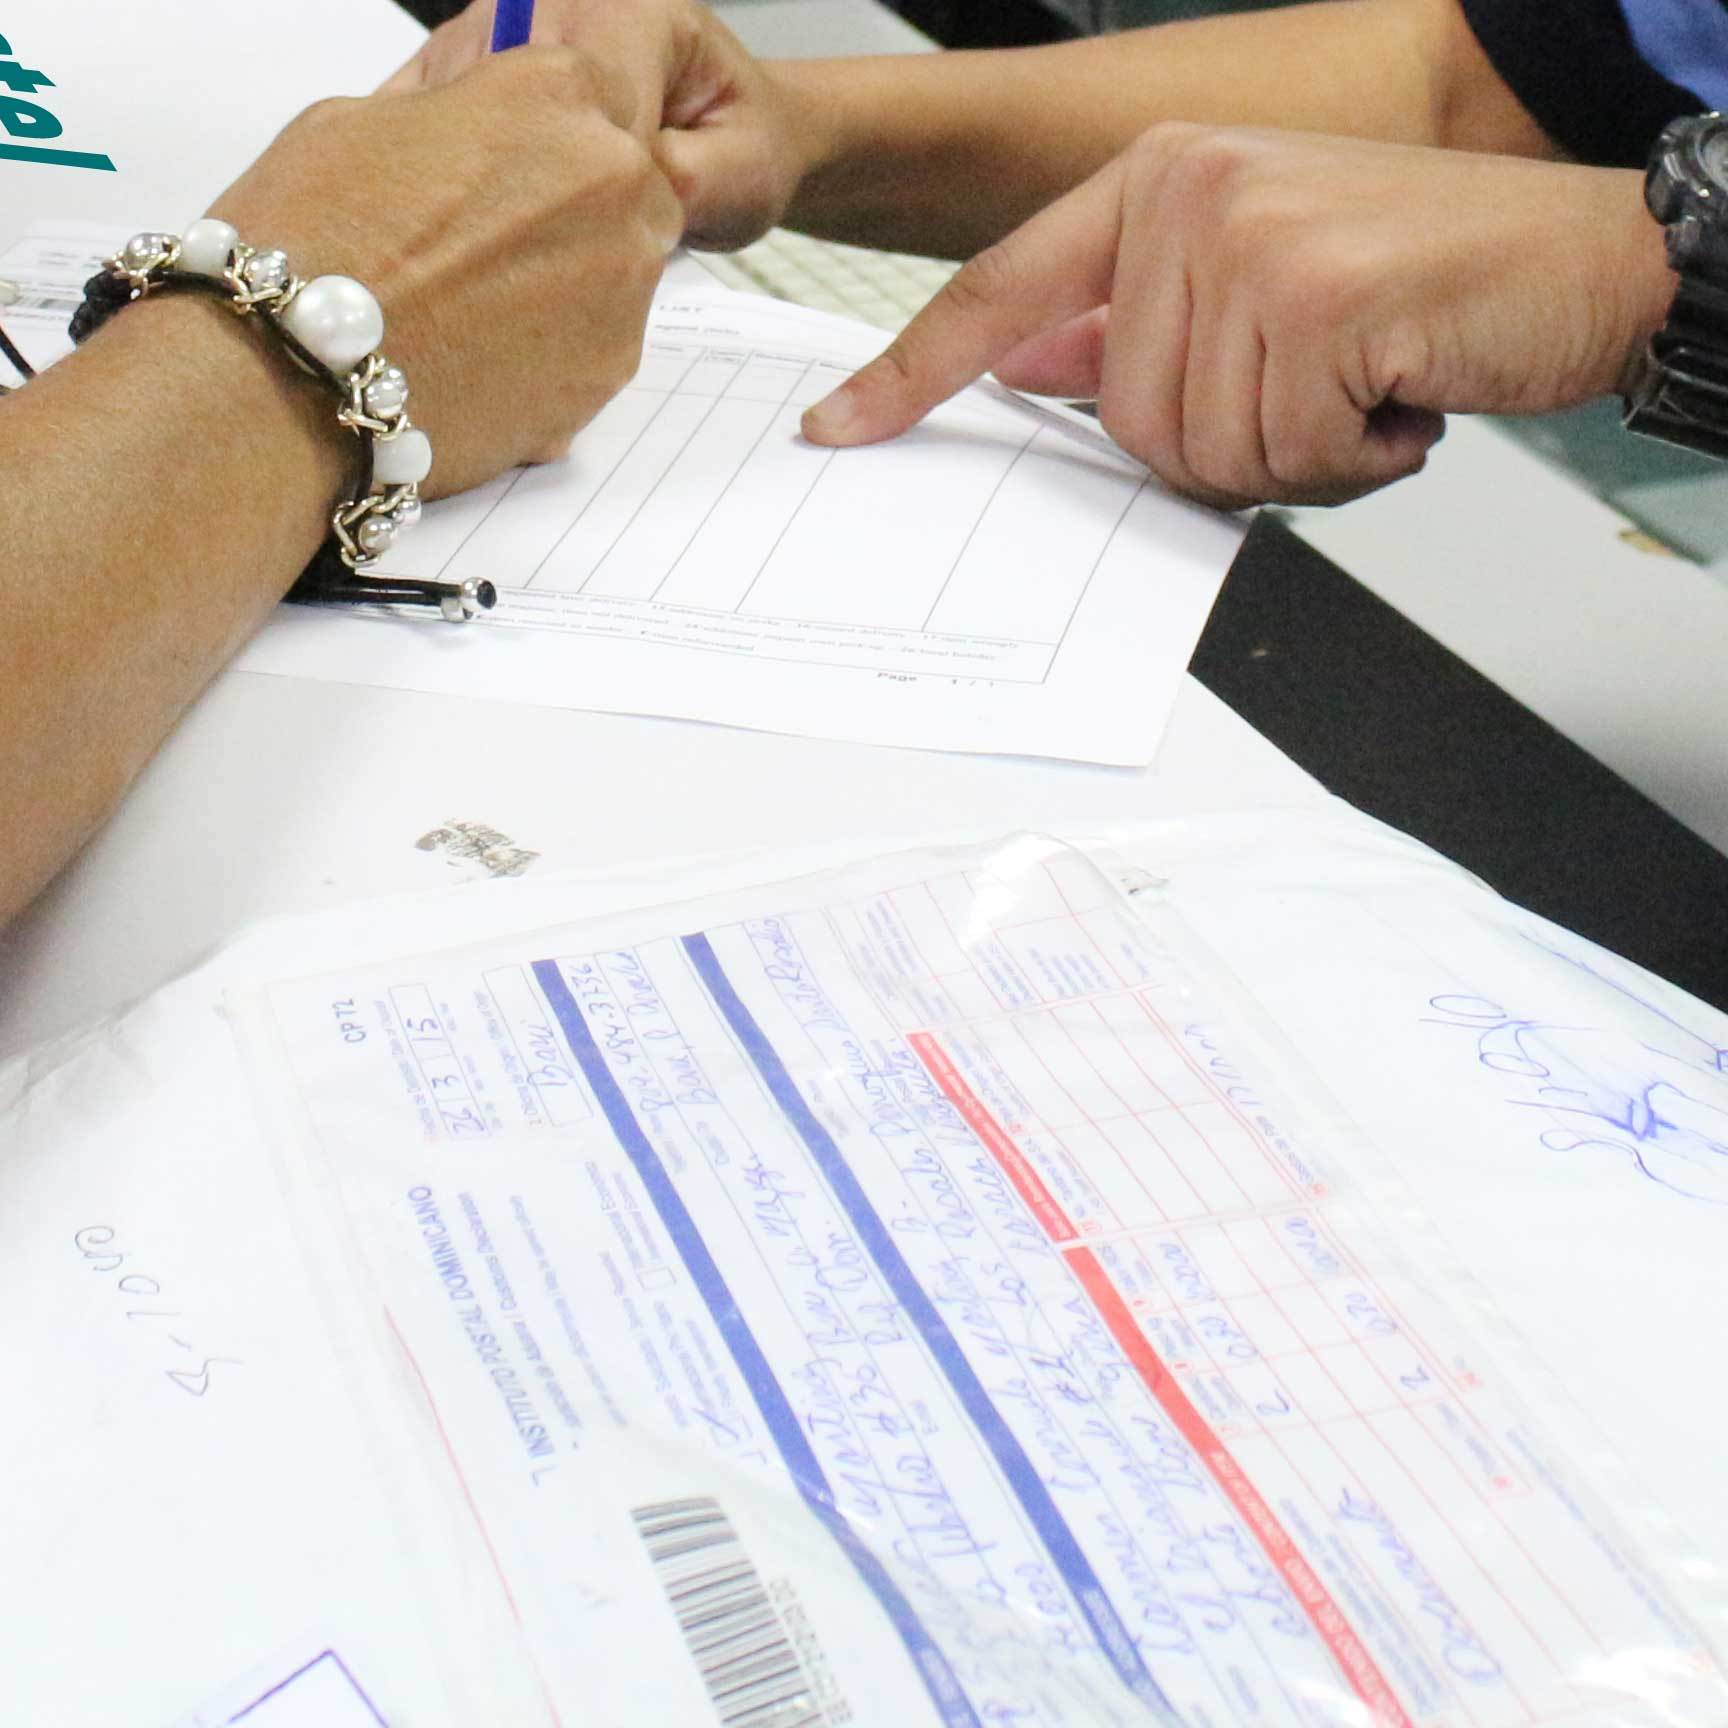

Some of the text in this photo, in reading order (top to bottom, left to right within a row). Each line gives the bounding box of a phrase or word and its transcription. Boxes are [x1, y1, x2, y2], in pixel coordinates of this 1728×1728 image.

[328, 997, 369, 1044] CP 72
[399, 1184, 483, 1302] DOMINICANO
[453, 1304, 509, 1364] POSTAL
[487, 1366, 558, 1457] INSTITUTO
